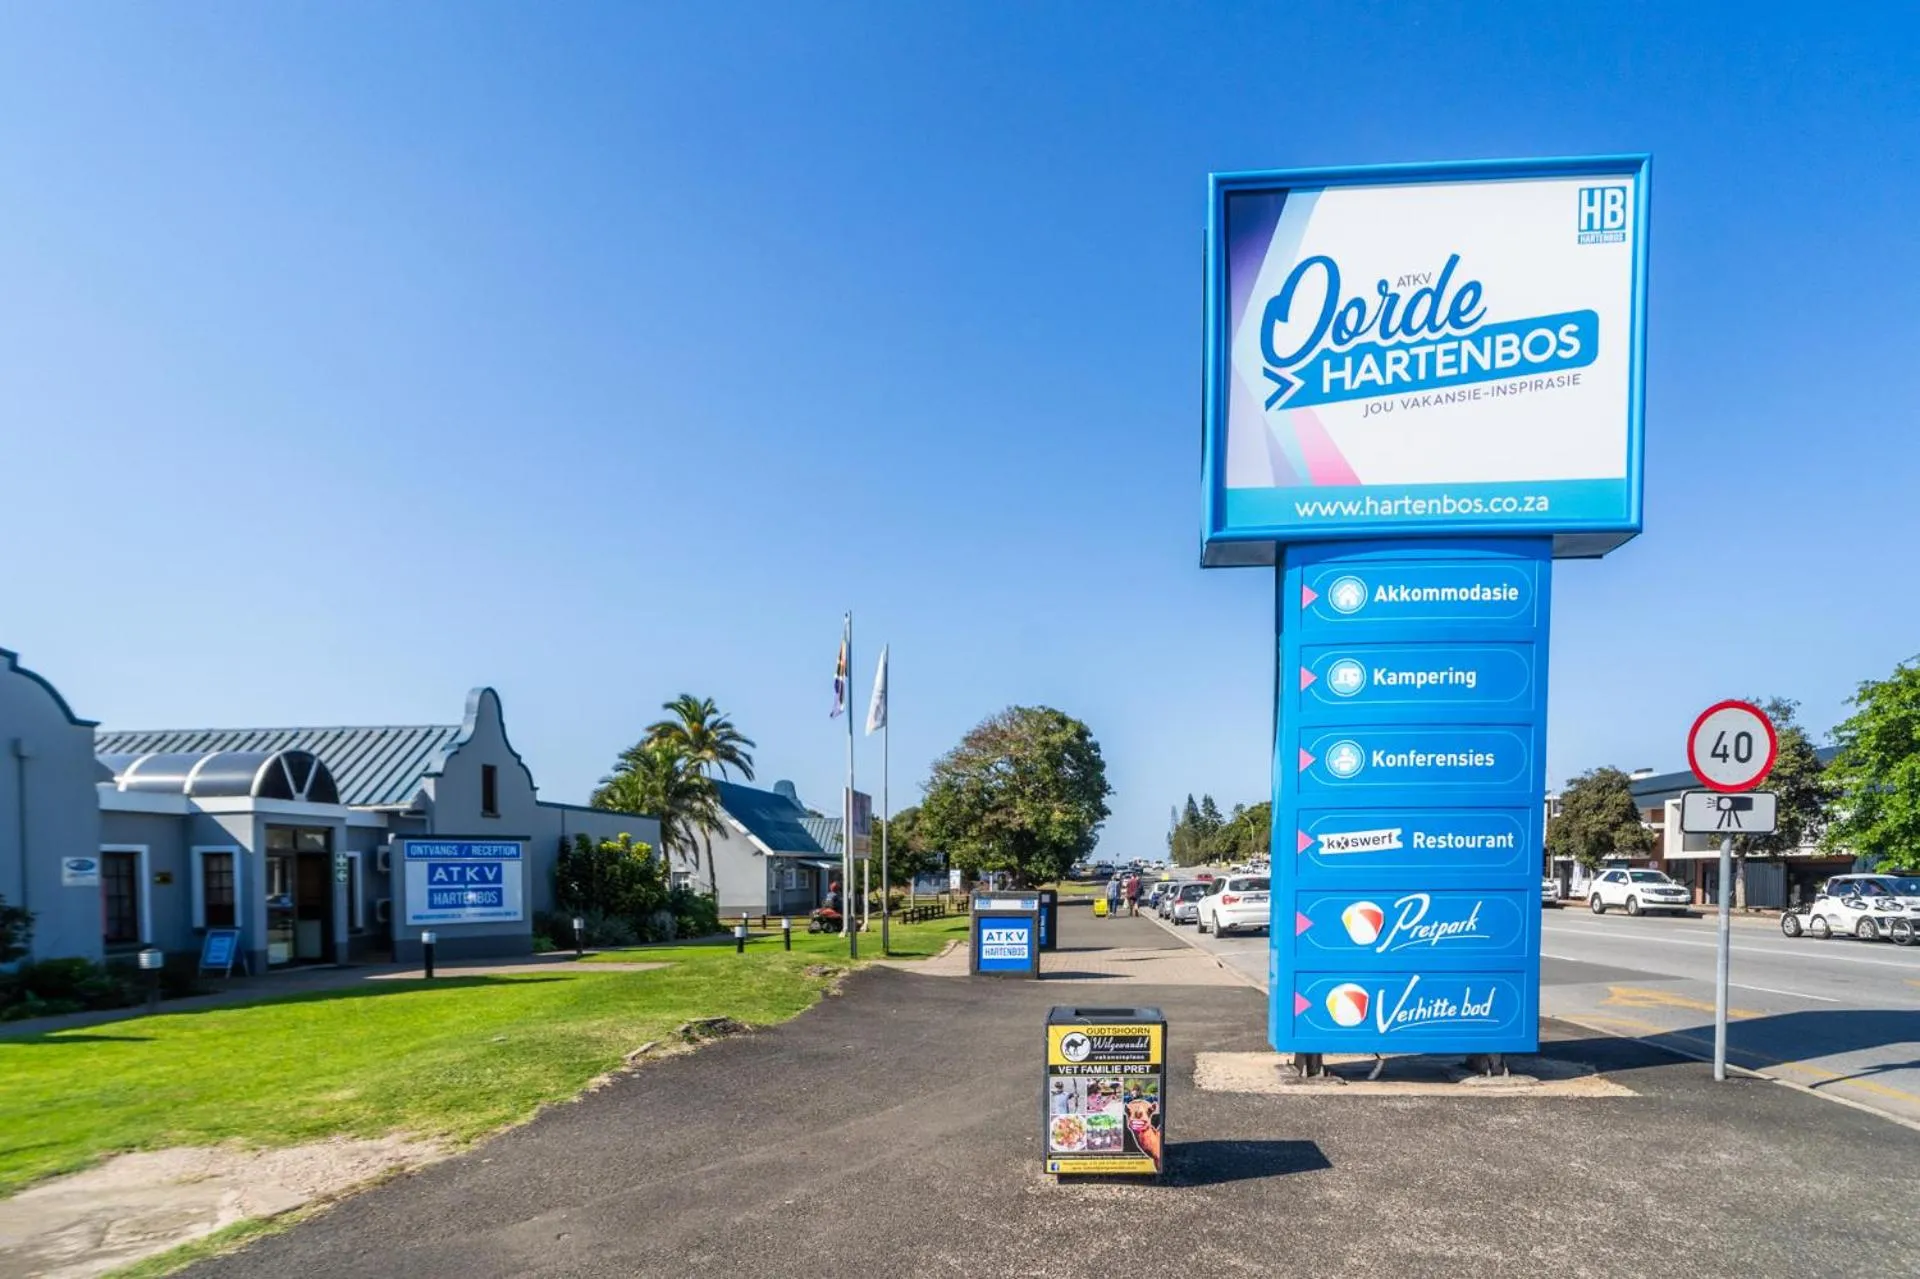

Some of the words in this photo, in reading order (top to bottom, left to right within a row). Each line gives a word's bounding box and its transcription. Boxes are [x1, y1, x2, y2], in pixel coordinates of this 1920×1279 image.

[1580, 188, 1624, 230] HB
[1397, 271, 1432, 288] ATKV
[1260, 253, 1487, 368] Oorde
[1322, 323, 1581, 393] HARTENBOS
[1363, 401, 1394, 418] JOU
[1401, 373, 1582, 411] VAKANSIE-INSPIRASIE
[1295, 493, 1549, 517] www.hartenbos.co.za
[1374, 584, 1518, 602] Akkommodasie
[1373, 667, 1477, 689] Kampering
[1372, 749, 1495, 767] Konferensies
[1711, 731, 1753, 763] 40
[471, 845, 517, 856] RECEPTION
[1376, 893, 1483, 953] Pretpark
[1376, 975, 1457, 1034] Verhitte
[1461, 987, 1496, 1016] bad
[1058, 1066, 1079, 1074] VET
[1081, 1065, 1122, 1074] FAMILIE
[1123, 1064, 1152, 1073] PRET
